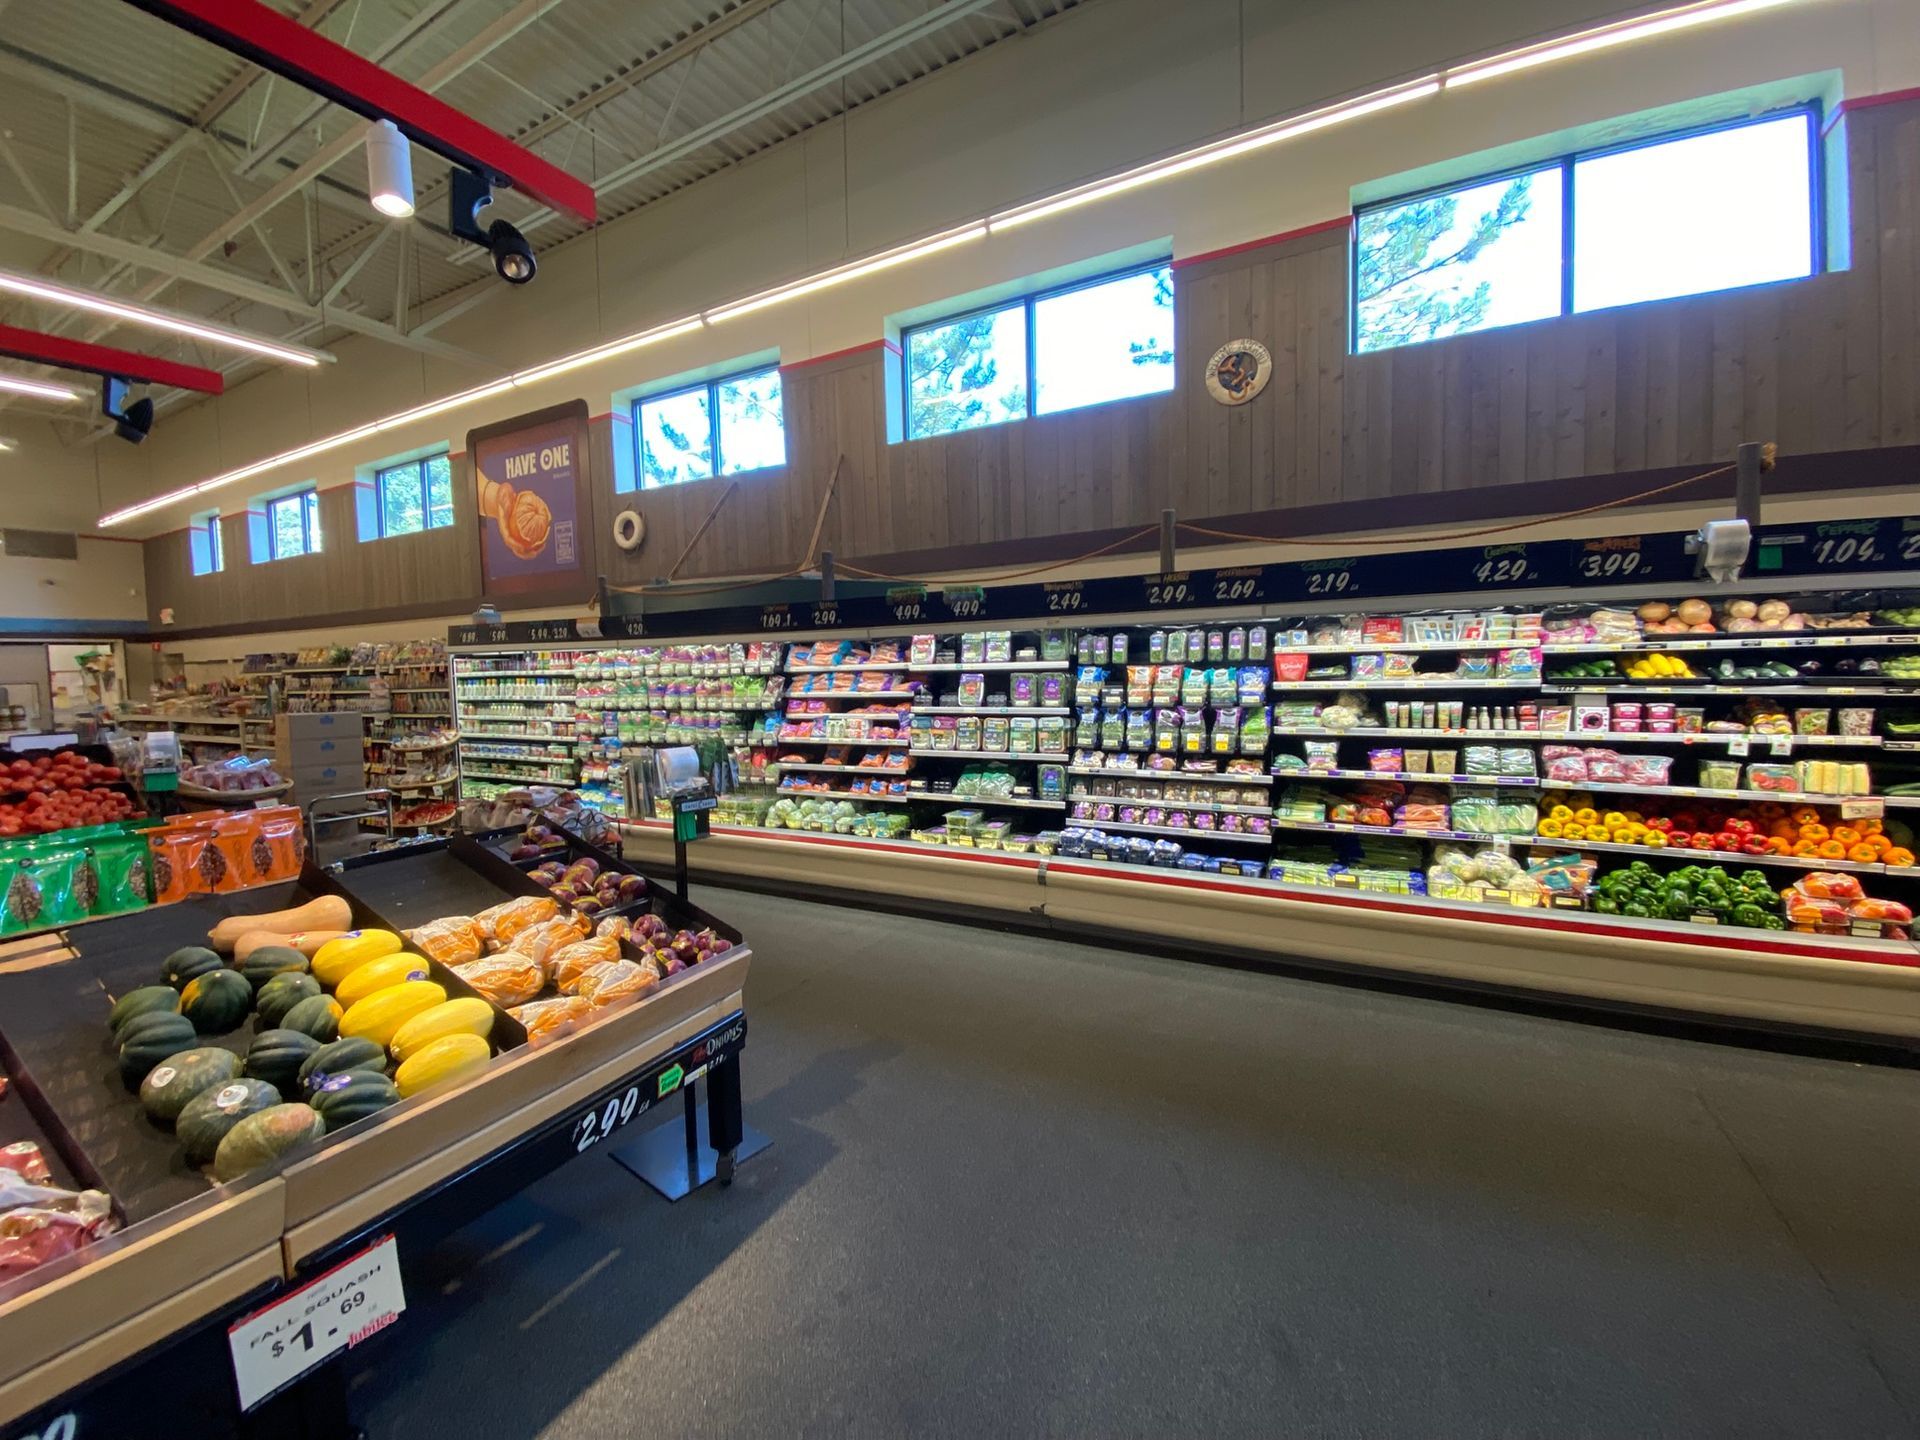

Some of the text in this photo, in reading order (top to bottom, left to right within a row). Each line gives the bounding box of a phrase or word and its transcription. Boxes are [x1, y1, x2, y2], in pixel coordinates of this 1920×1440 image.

[506, 444, 570, 479] HAVE ONE
[705, 1020, 743, 1056] ONIONS
[250, 1264, 382, 1350] FALL SQUASH
